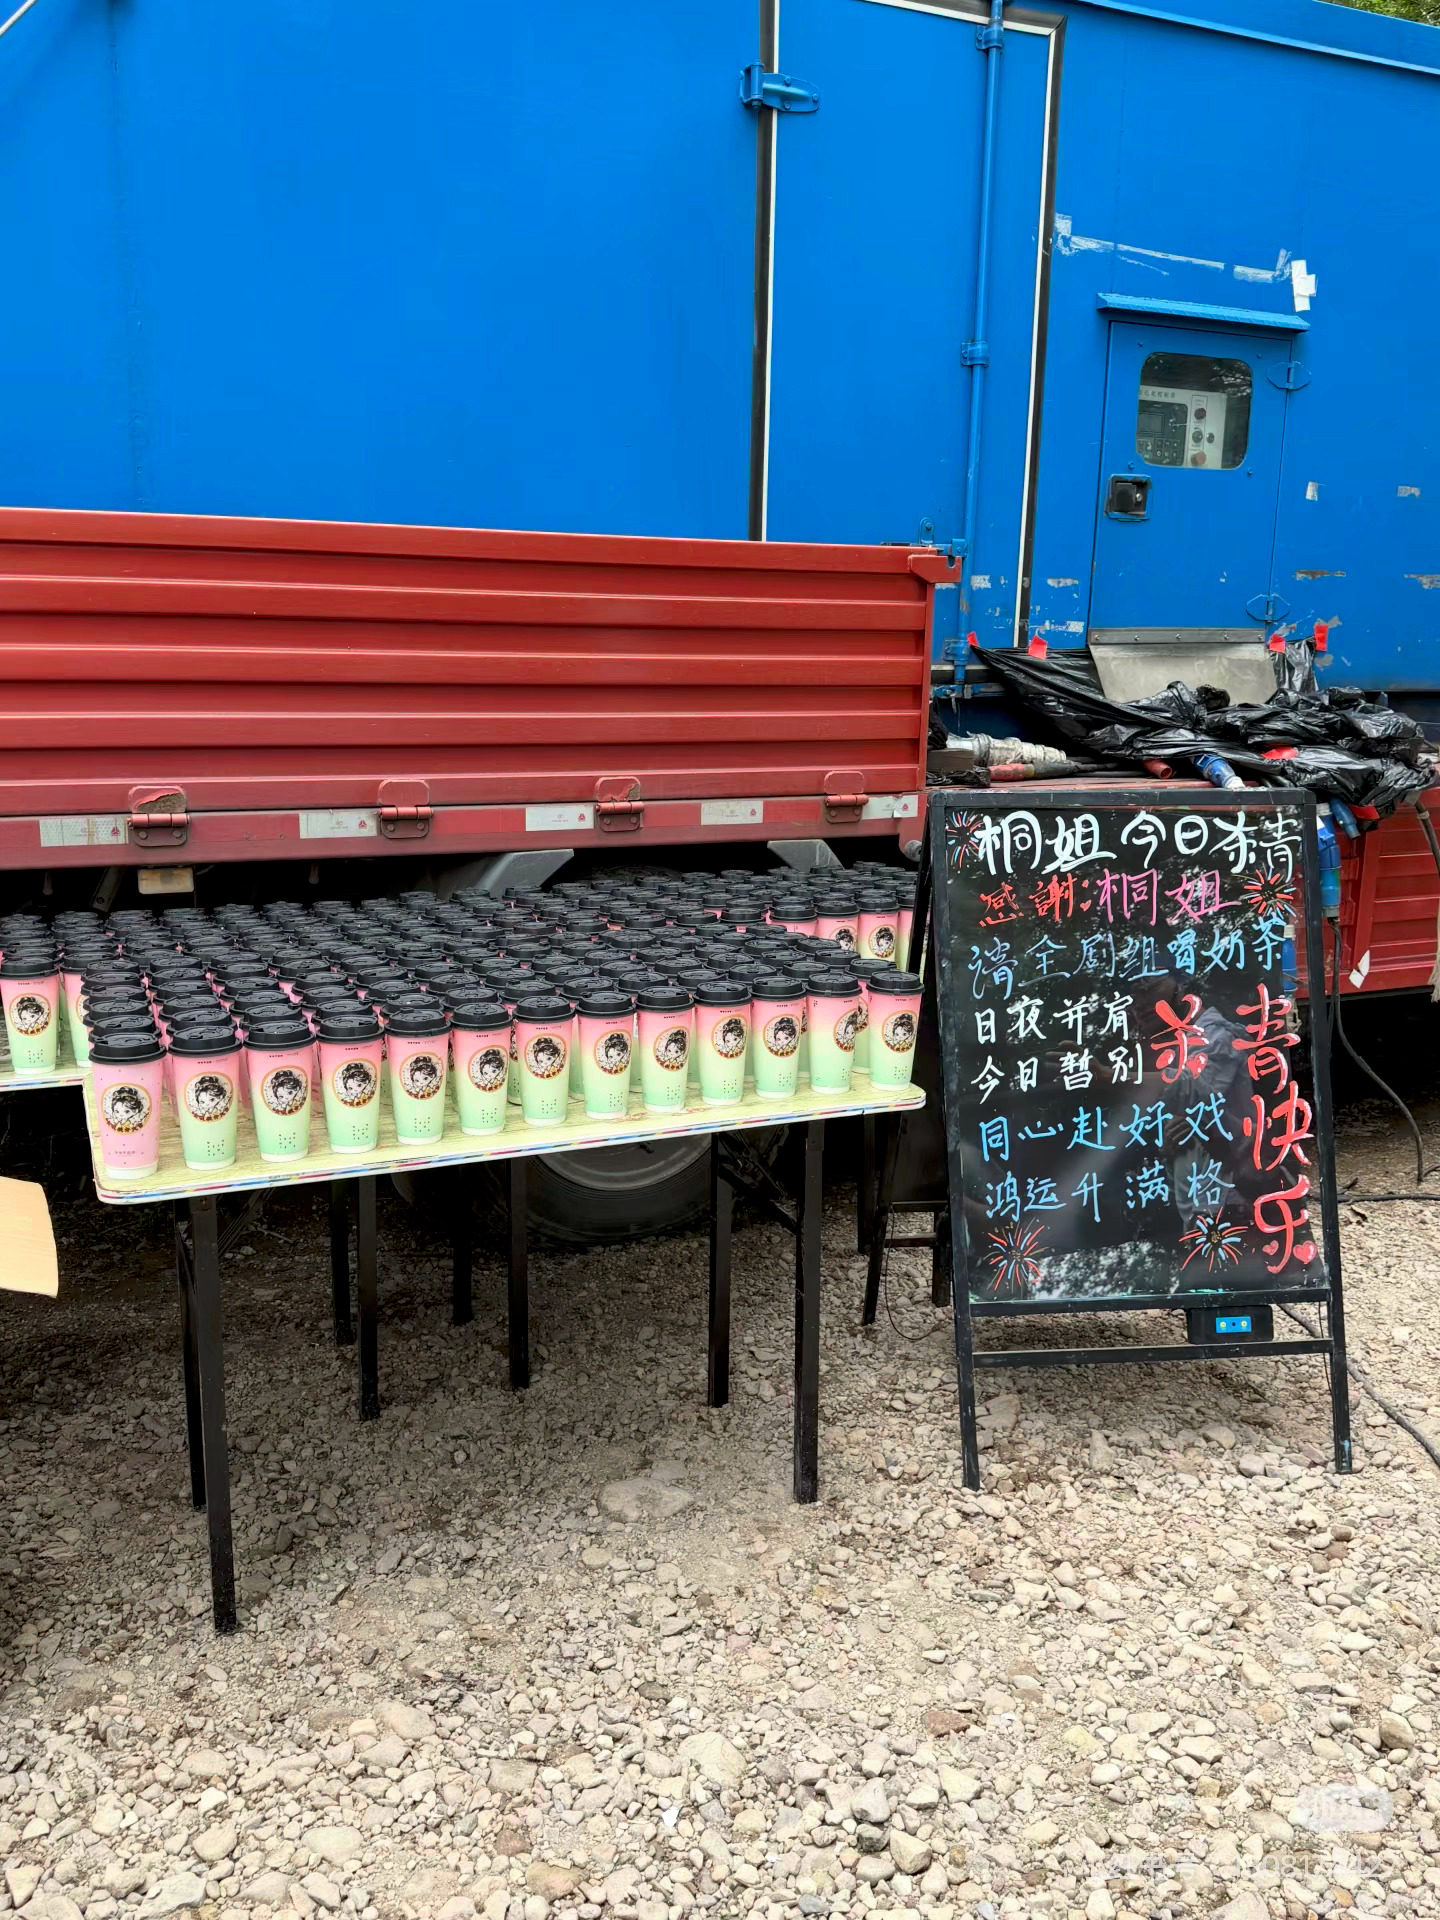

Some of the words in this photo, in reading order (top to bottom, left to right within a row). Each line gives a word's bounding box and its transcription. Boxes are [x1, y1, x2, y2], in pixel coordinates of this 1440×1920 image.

[968, 916, 1287, 1000] 请全剧组喝奶茶
[974, 991, 1134, 1045] 日夜并肩
[971, 1043, 1143, 1105] 今日暂别
[979, 1092, 1234, 1162] 同心赴好戏
[985, 1158, 1236, 1224] 鸿运升满格
